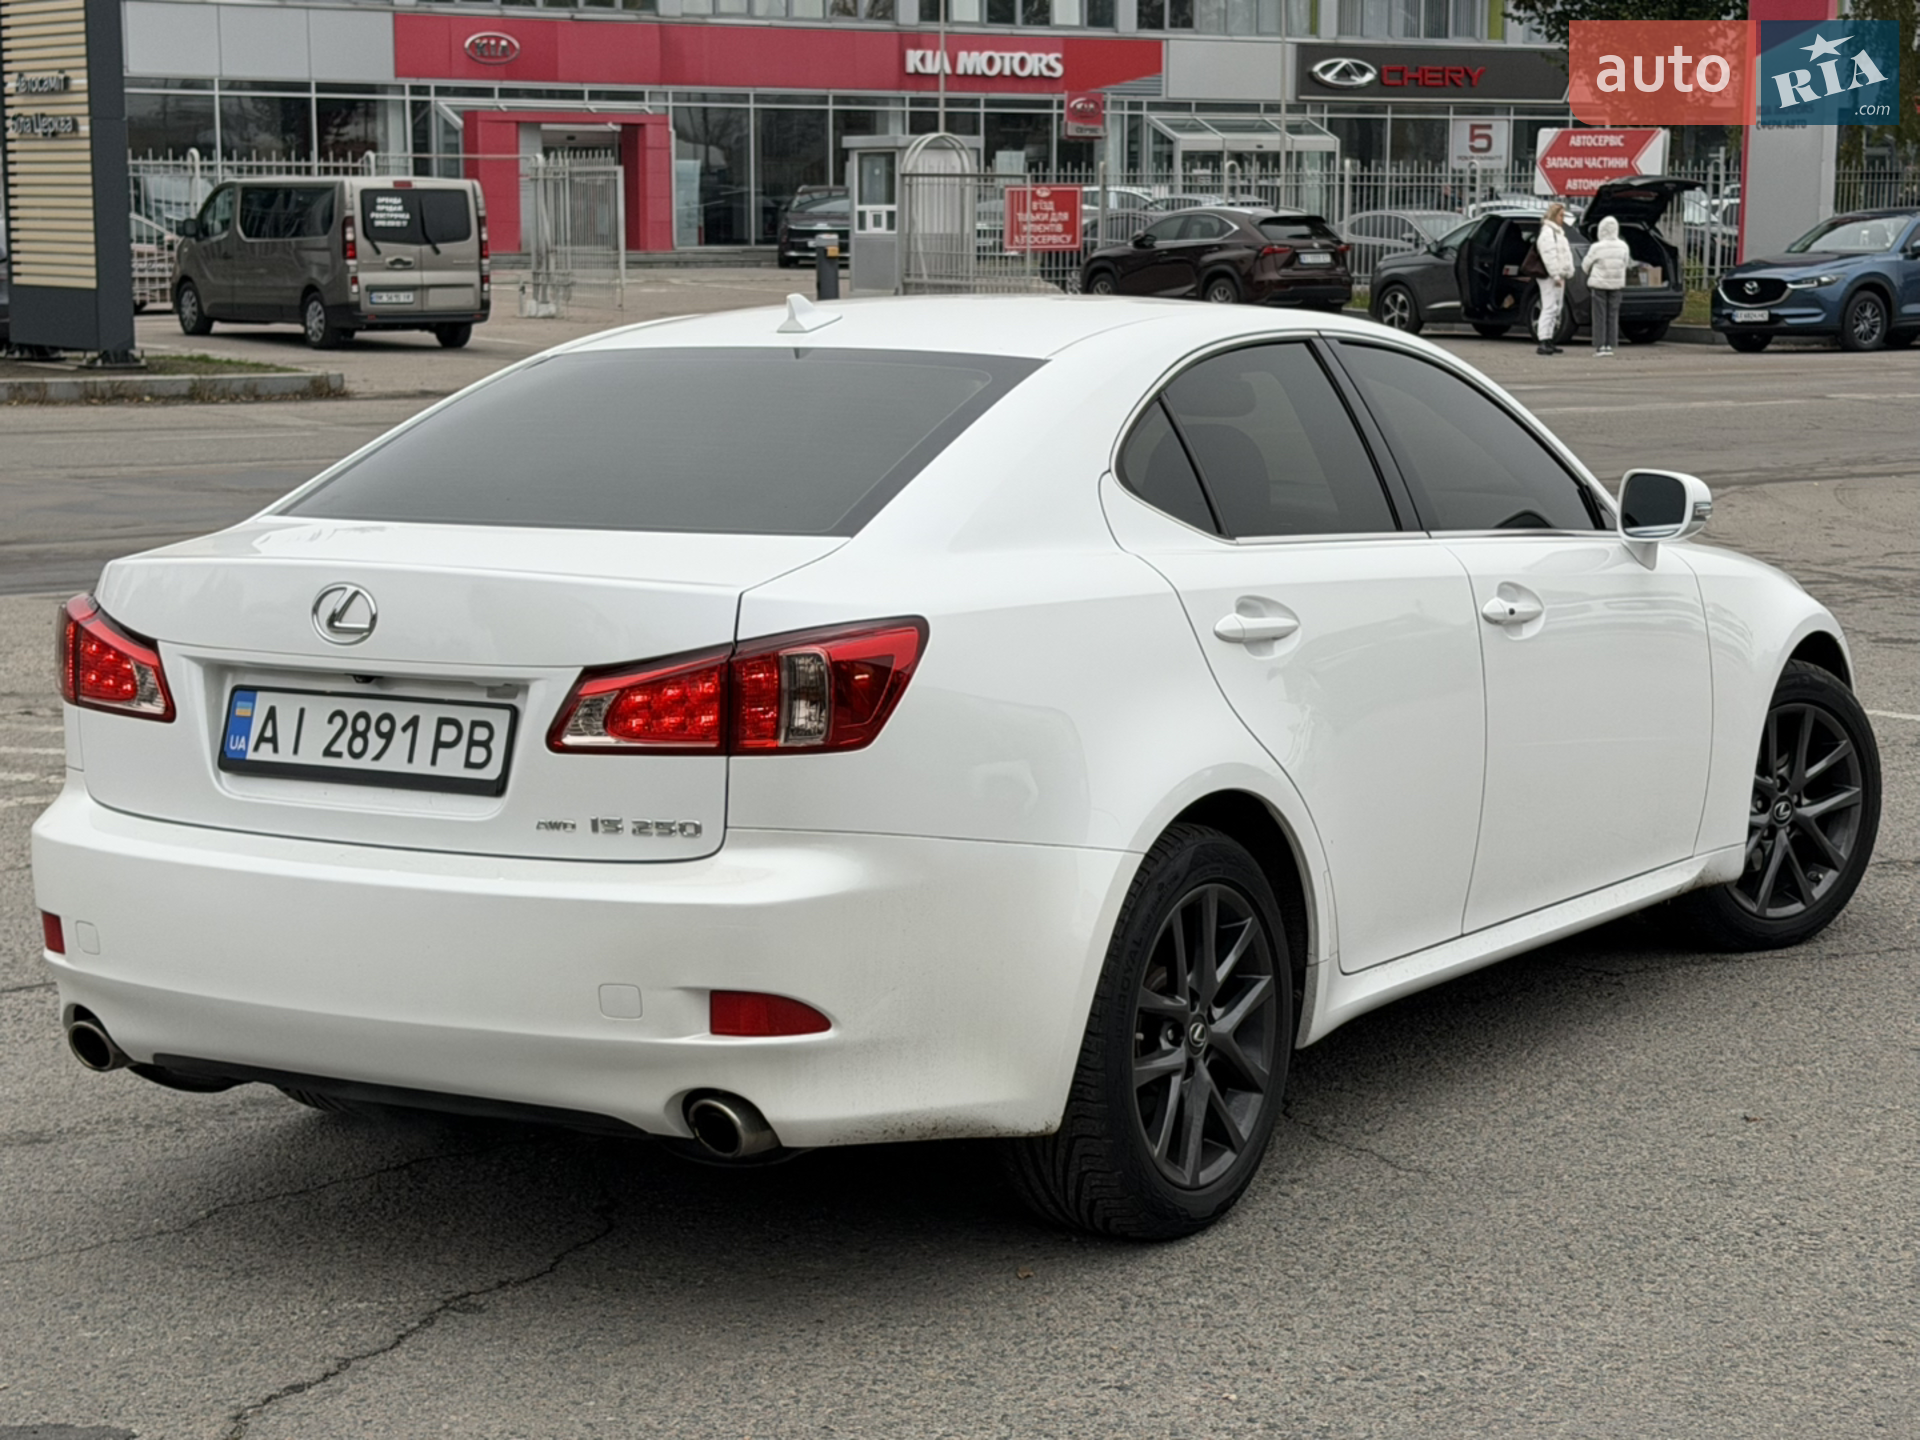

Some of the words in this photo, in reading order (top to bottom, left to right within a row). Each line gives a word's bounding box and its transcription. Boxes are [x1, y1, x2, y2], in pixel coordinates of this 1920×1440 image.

[905, 49, 952, 74] KIA
[956, 51, 1064, 78] MOTORS
[1381, 64, 1486, 87] CHERY
[1468, 124, 1492, 153] 5
[1569, 135, 1625, 147] АВТОСЕРВІС
[1545, 156, 1583, 169] ЗАПАСНІ
[1584, 156, 1628, 169] ЧАСТИНИ
[1049, 211, 1069, 223] ДЛЯ
[229, 735, 247, 751] UA
[252, 705, 305, 756] AI
[322, 709, 420, 764] 2891
[430, 716, 495, 770] PB
[537, 819, 576, 833] AWD
[590, 816, 624, 835] IS
[631, 818, 703, 838] 250
